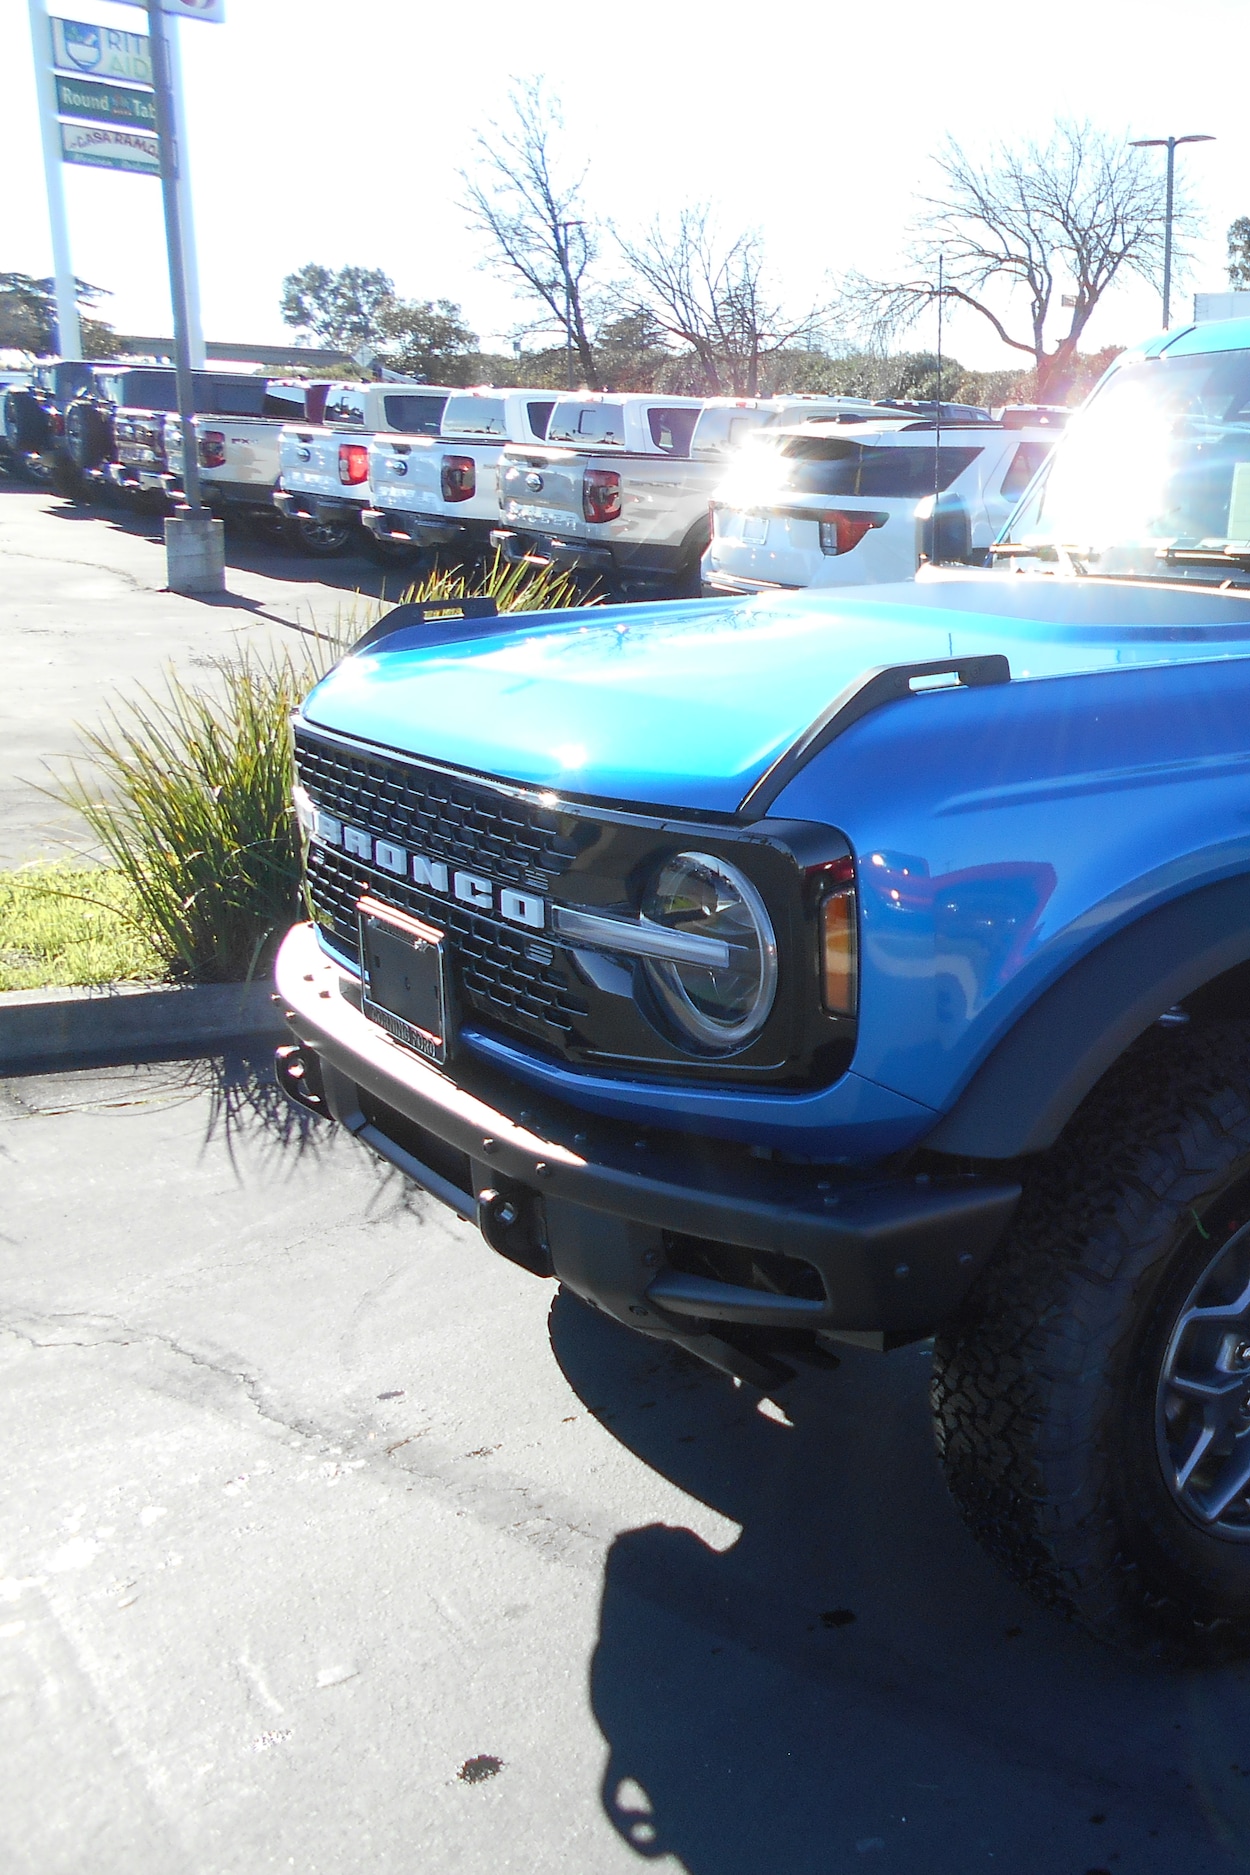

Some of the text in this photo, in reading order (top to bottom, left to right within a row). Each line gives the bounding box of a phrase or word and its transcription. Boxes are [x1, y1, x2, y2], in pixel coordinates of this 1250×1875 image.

[107, 29, 147, 55] RIT
[109, 54, 150, 78] AID
[62, 86, 110, 111] Round
[76, 132, 159, 158] CASA RAMO
[313, 811, 545, 929] BRONCO
[411, 1029, 436, 1057] FORD
